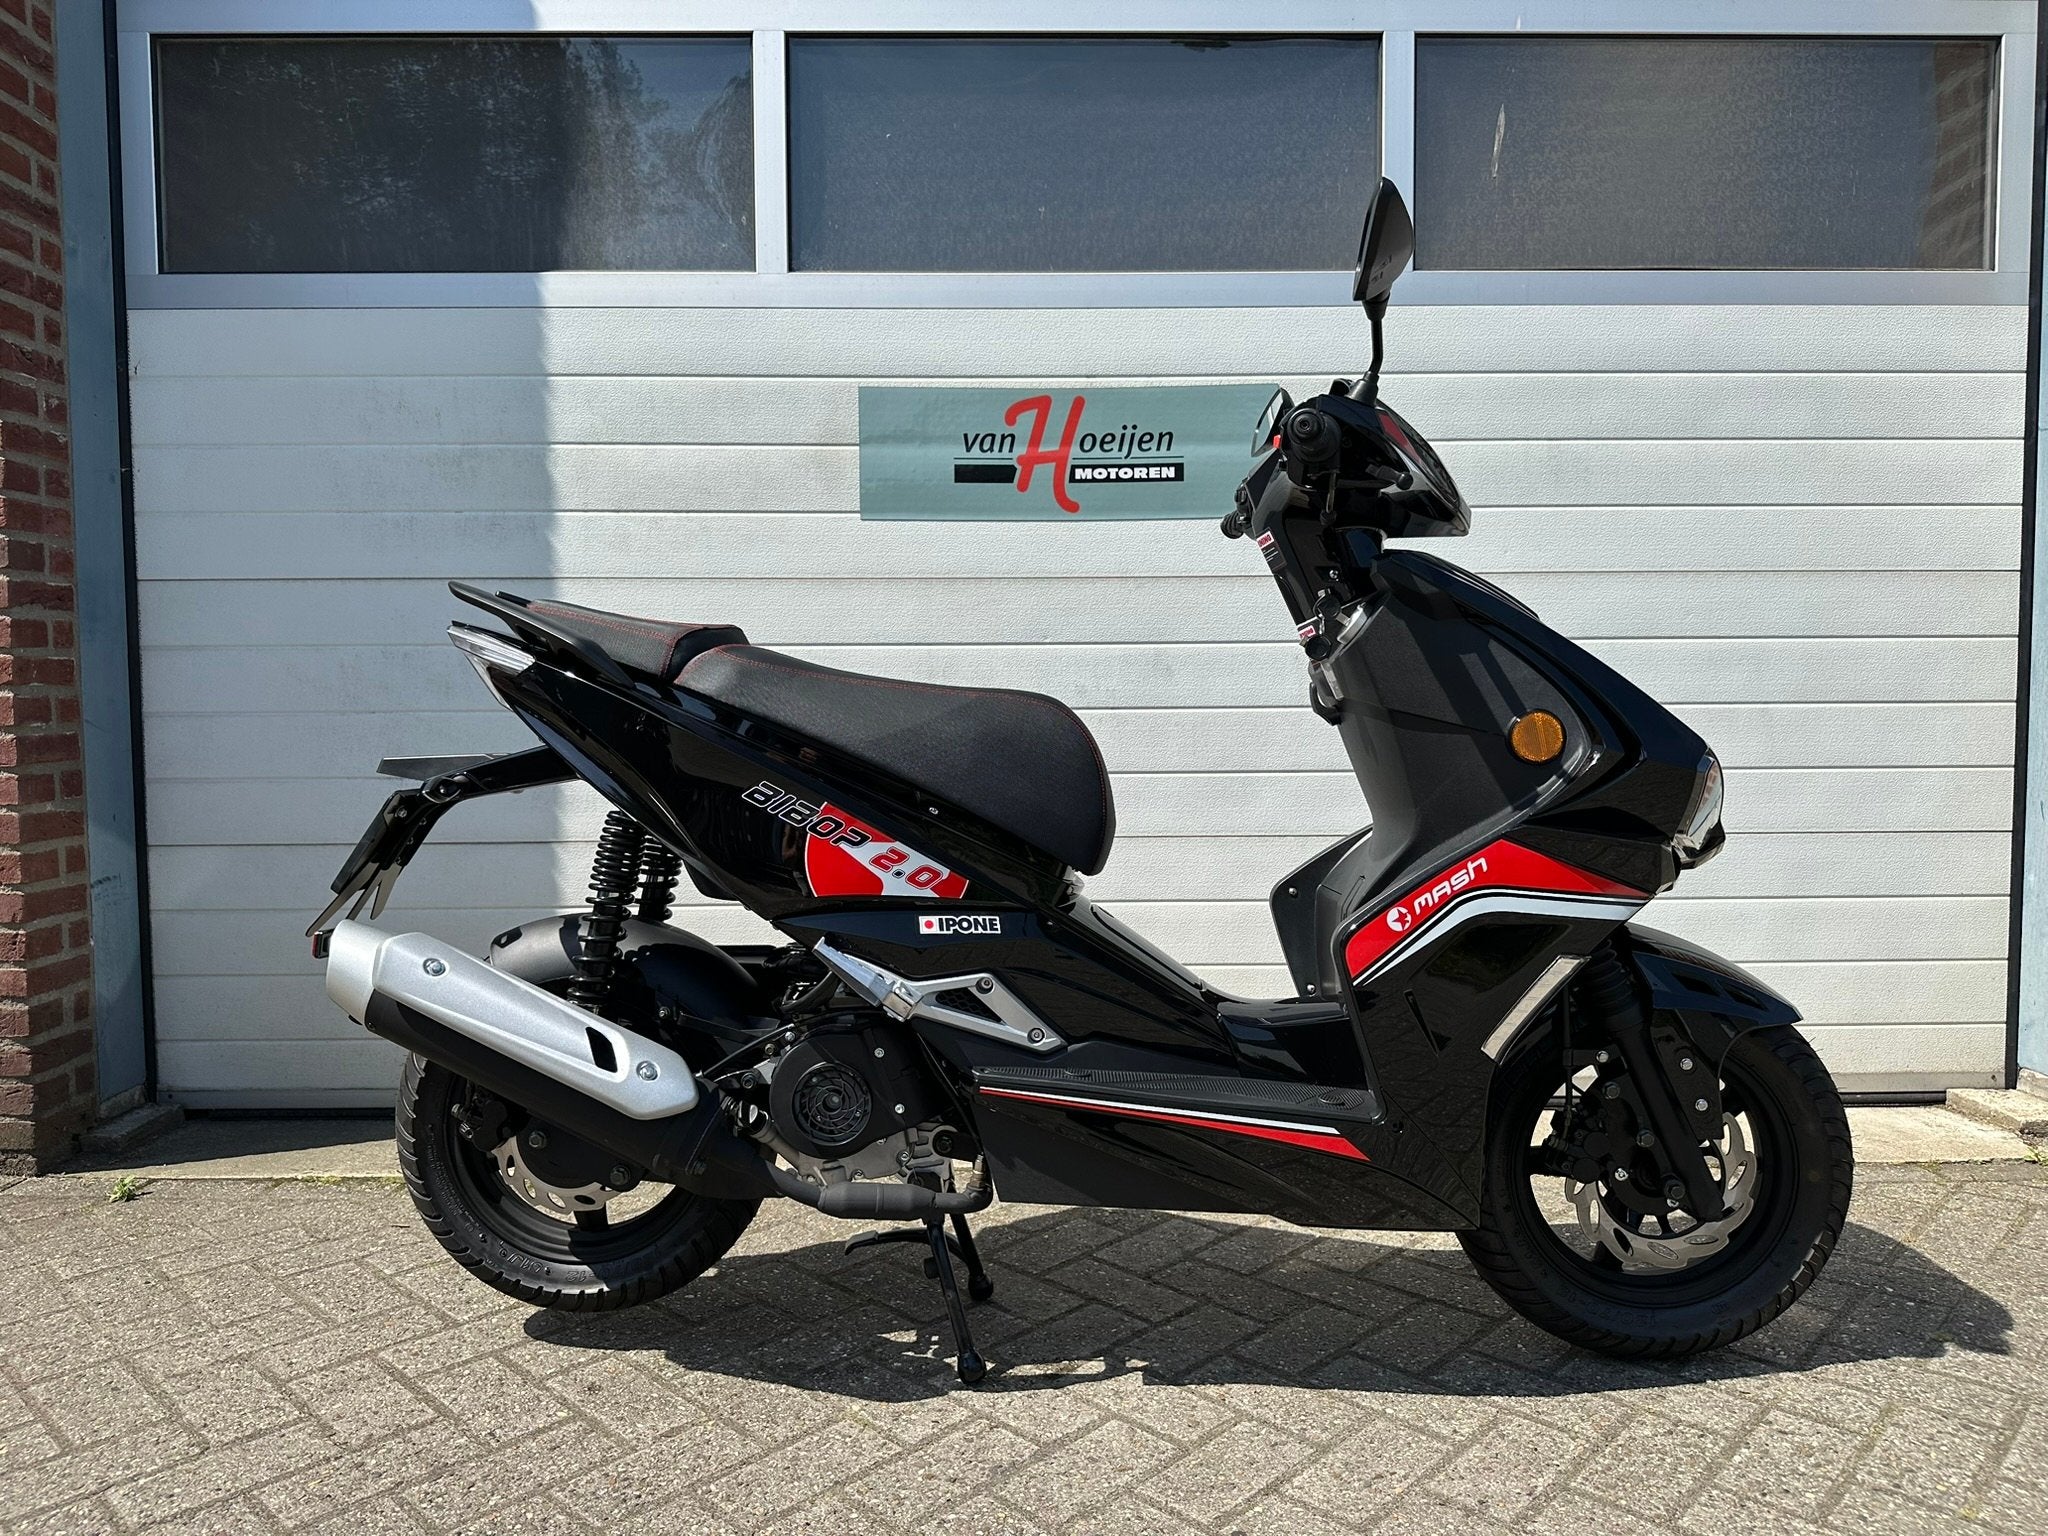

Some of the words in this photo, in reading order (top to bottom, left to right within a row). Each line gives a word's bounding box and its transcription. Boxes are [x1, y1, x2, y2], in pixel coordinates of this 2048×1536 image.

[963, 430, 1015, 454] van
[1004, 394, 1174, 514] Hoeijen
[1075, 465, 1175, 480] MOTOREN
[868, 846, 944, 889] 2.0
[938, 916, 1000, 933] IPONE
